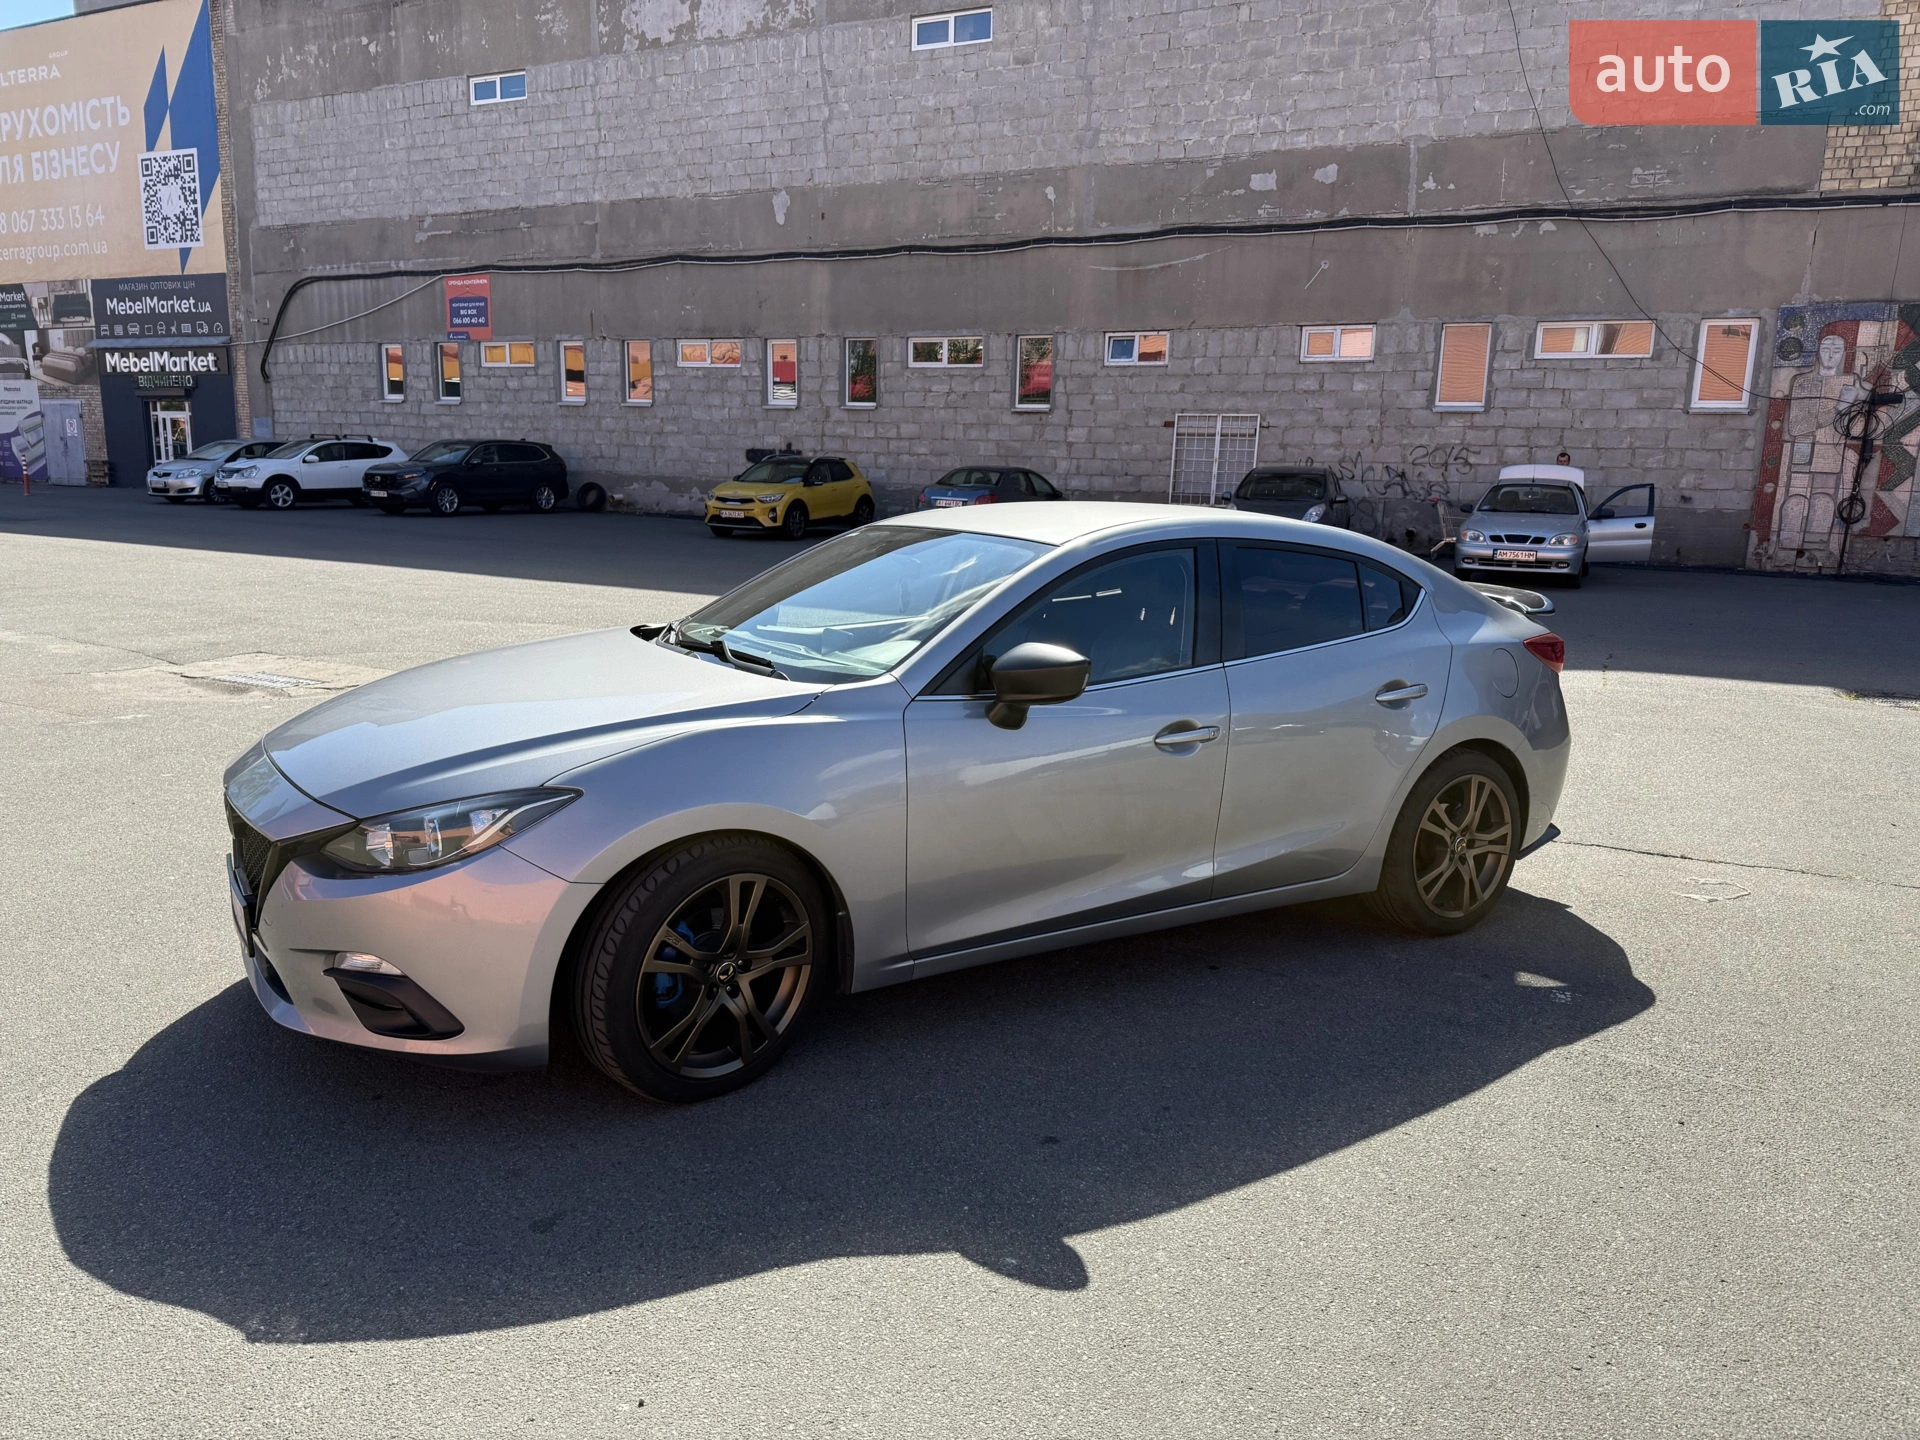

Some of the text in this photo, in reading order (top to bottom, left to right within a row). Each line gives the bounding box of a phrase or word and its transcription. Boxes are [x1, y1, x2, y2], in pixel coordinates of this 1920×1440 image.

[31, 141, 120, 182] БІЗНЕСУ
[11, 209, 36, 233] 067
[40, 207, 65, 231] 333
[69, 204, 82, 229] 13
[86, 204, 105, 228] 64
[118, 281, 195, 292] МАГАЗИН ОПТОВИХ ЦІН
[105, 350, 218, 373] MebelMarket
[138, 375, 193, 388] ВІДЧИНЕНО
[1509, 551, 1524, 559] 7561
